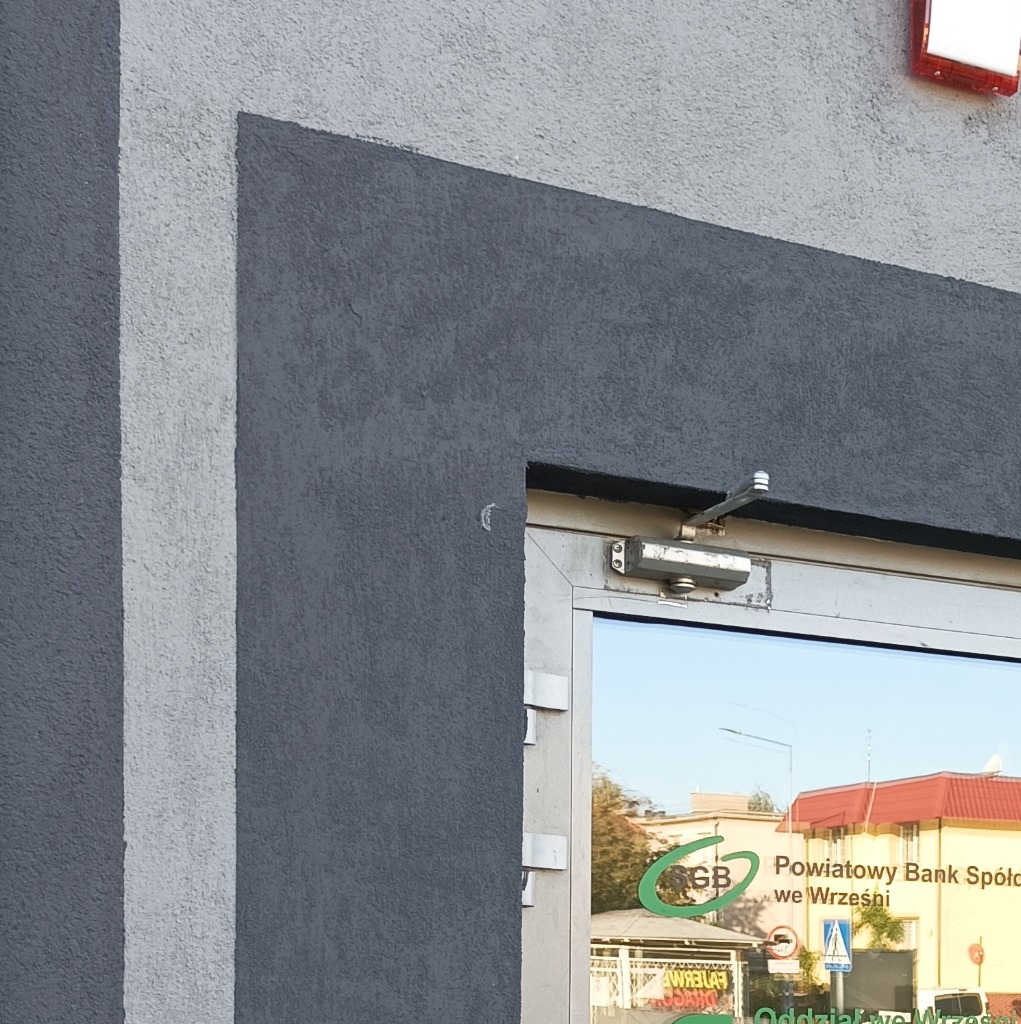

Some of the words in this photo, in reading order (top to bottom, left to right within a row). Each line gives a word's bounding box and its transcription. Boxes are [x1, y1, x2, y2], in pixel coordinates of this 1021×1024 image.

[669, 864, 732, 890] SGB
[775, 855, 898, 885] Powiatowy
[905, 862, 959, 884] Bank
[774, 889, 803, 904] we
[808, 886, 890, 908] Wrześni
